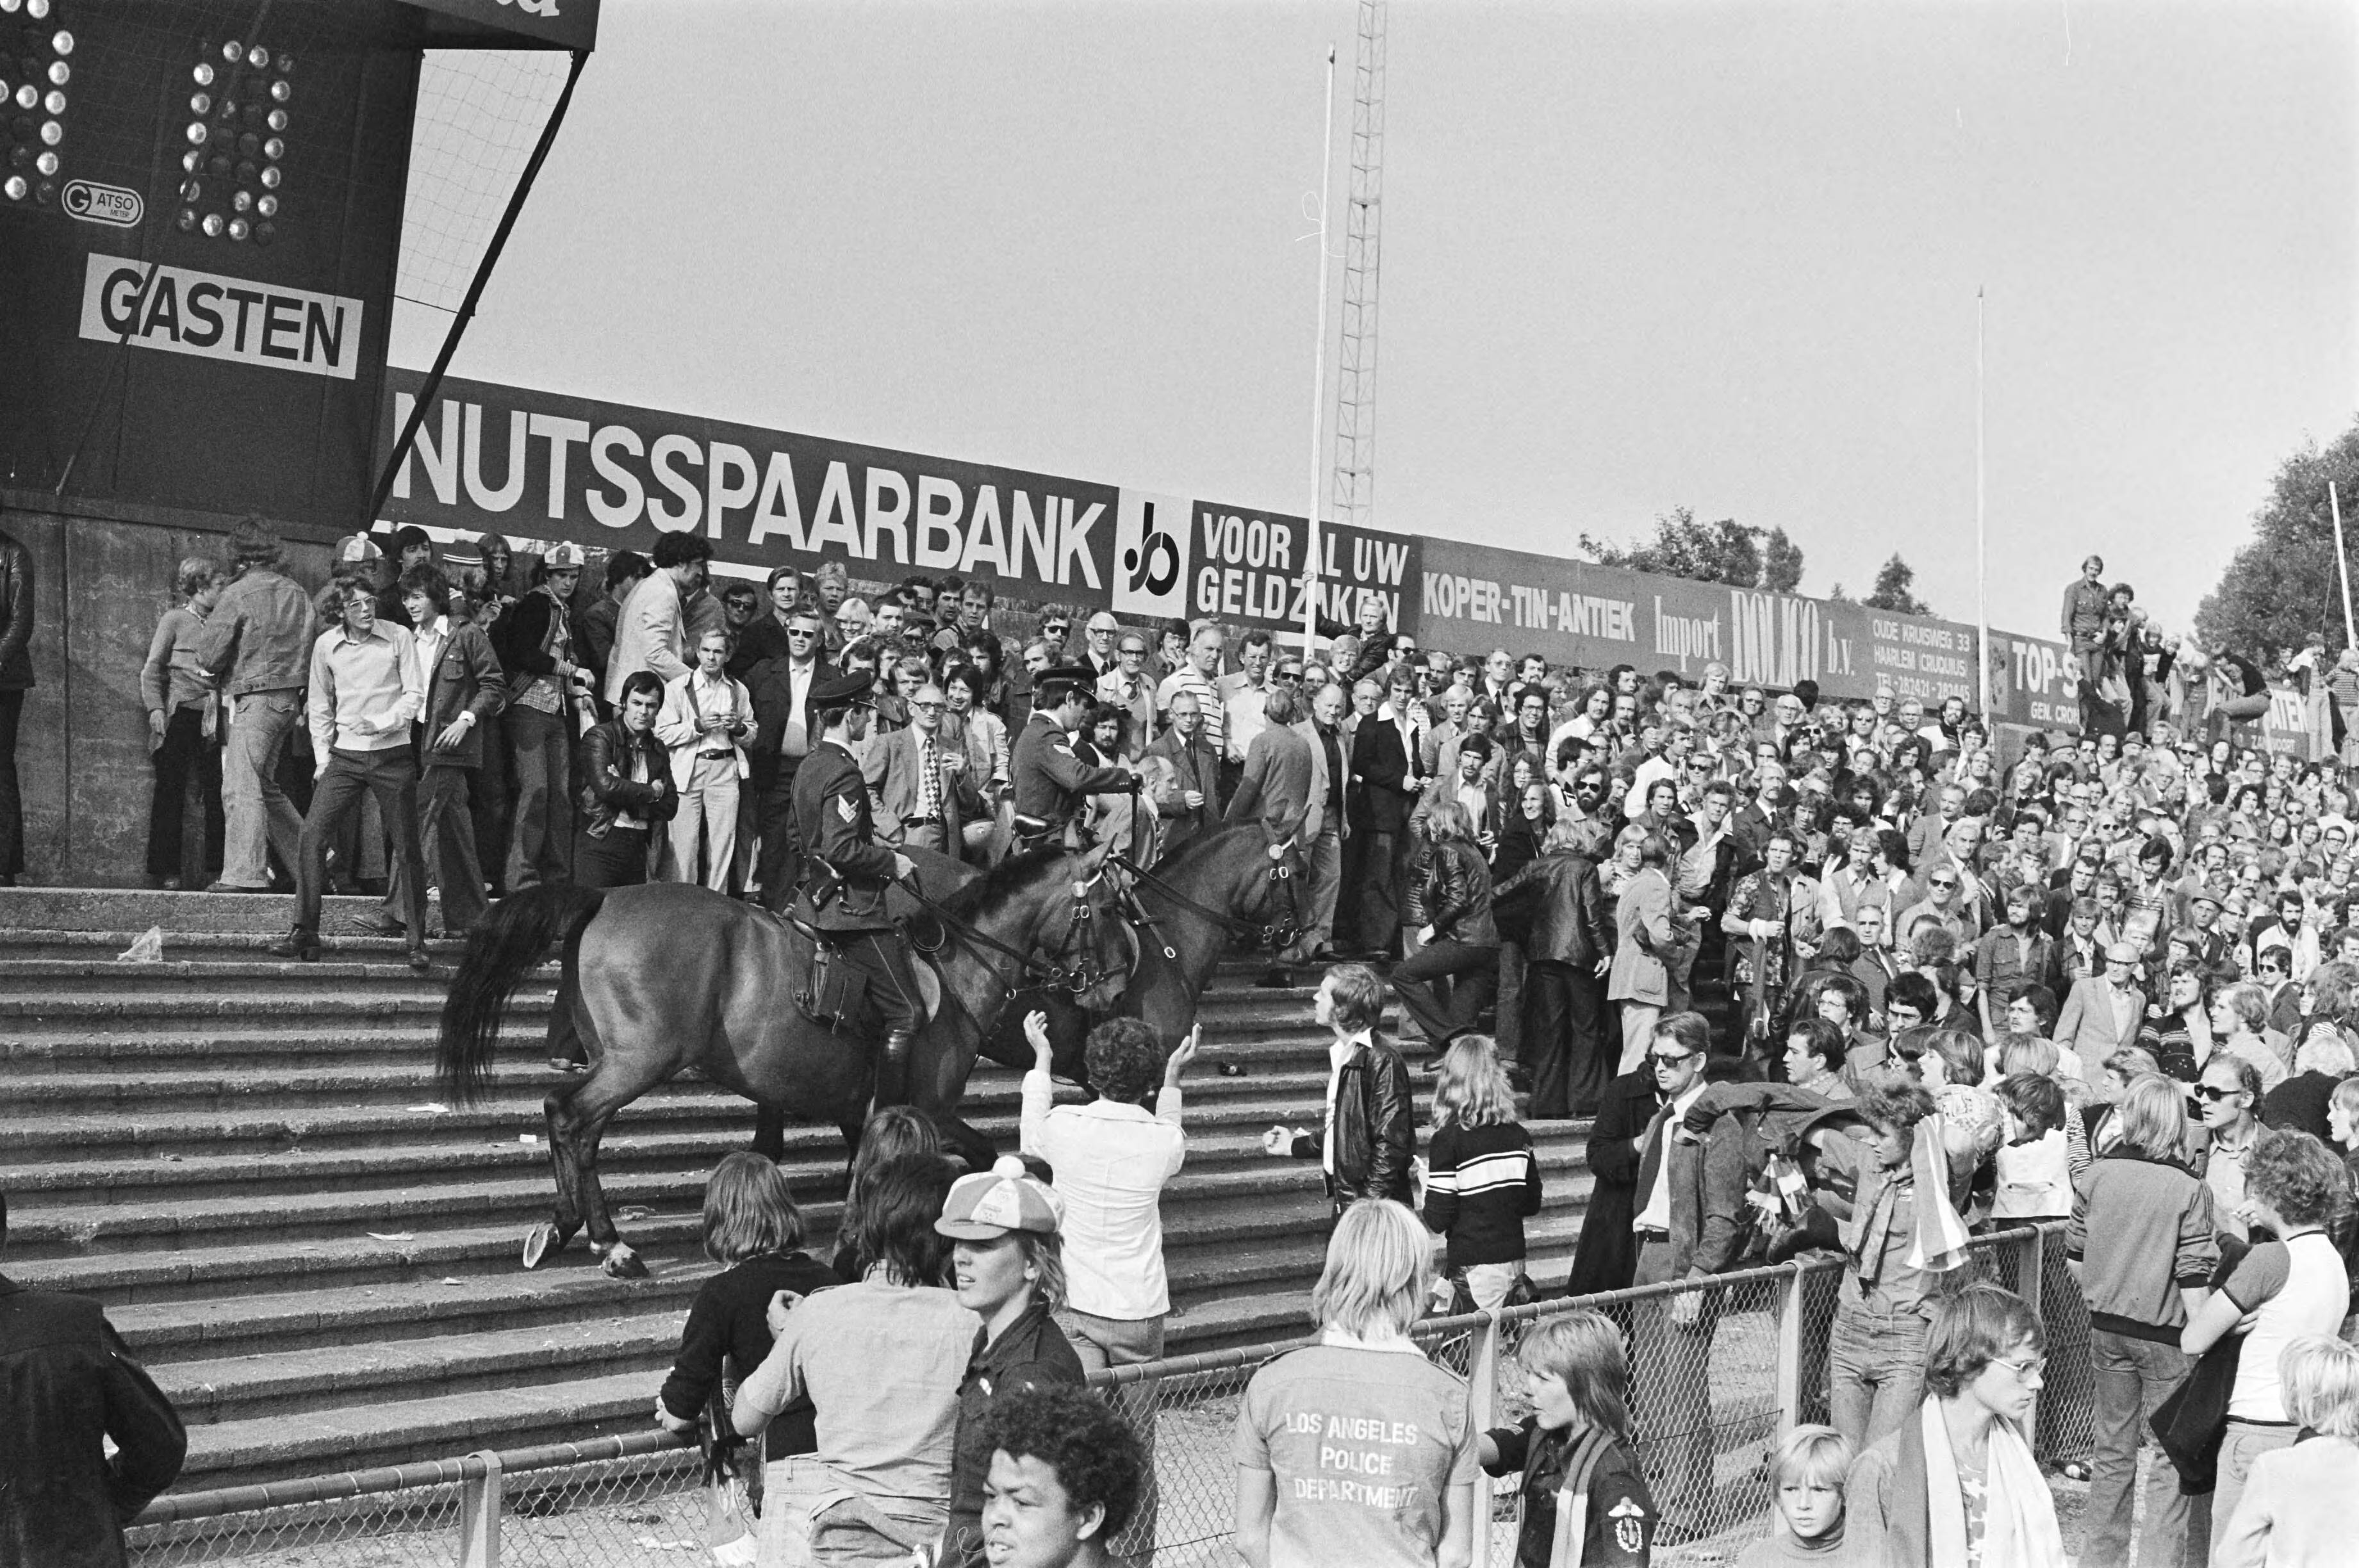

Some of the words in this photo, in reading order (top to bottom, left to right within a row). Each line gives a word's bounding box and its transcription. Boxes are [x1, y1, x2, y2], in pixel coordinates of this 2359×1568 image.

[101, 267, 345, 368] GASTEN
[392, 391, 1108, 590] NUTSSPAARBANK
[1203, 512, 1292, 570] VOOR
[1353, 536, 1409, 585] UW
[1654, 595, 1722, 673] Import
[1873, 618, 1899, 641] OUDE
[1902, 623, 1953, 649] KRUISWEG
[1957, 632, 1970, 653] 33
[1873, 644, 1916, 671] HAARLEM
[1285, 1412, 1323, 1434] LOS
[1327, 1416, 1418, 1446] ANGELES
[1320, 1446, 1392, 1475] POLICE
[1294, 1478, 1419, 1509] DEPARTMENT
